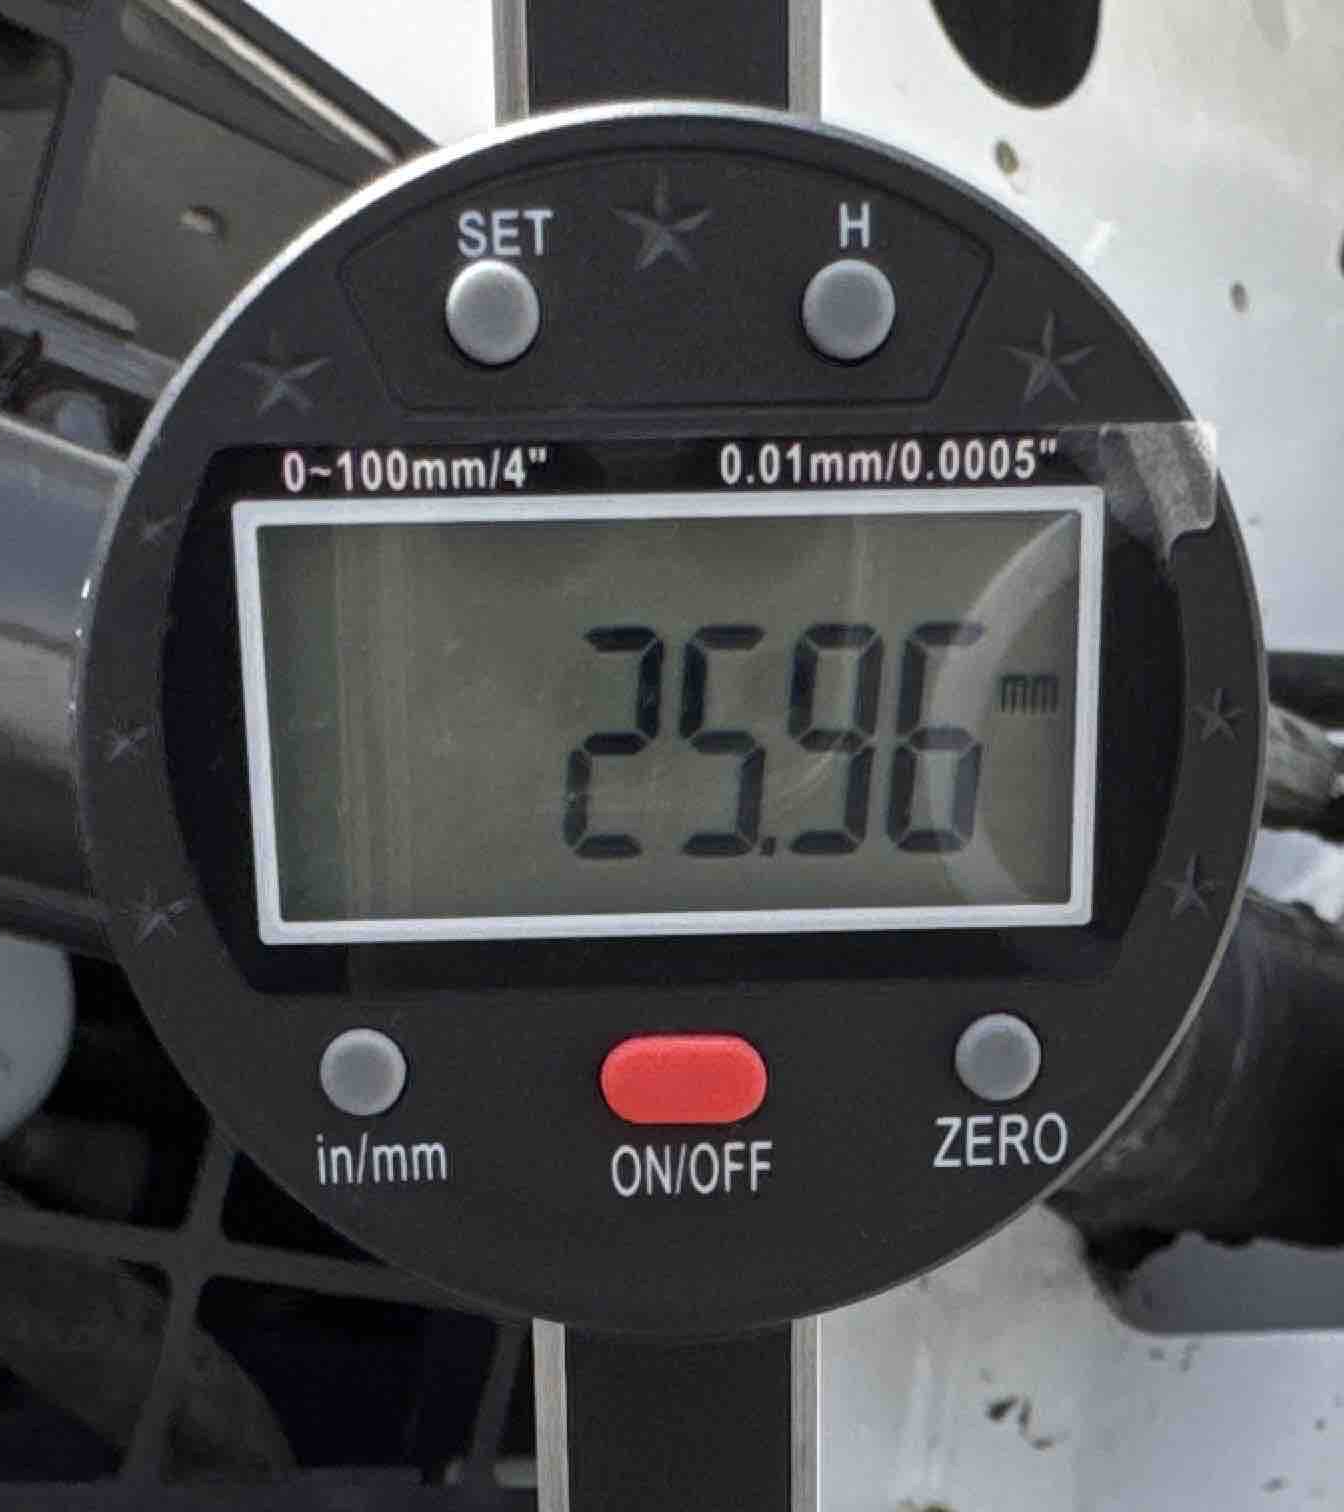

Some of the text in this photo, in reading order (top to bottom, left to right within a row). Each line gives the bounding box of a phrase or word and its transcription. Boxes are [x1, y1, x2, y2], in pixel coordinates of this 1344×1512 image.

[458, 209, 553, 258] SET
[840, 202, 870, 249] H
[282, 447, 547, 493] 0~100mm/4"
[720, 438, 1058, 486] 0.01mm/0.0005"
[563, 621, 1060, 859] 25.96 mm
[317, 1132, 448, 1185] in/mm
[933, 1112, 1069, 1169] ZERO
[611, 1140, 774, 1197] ON/OFF
